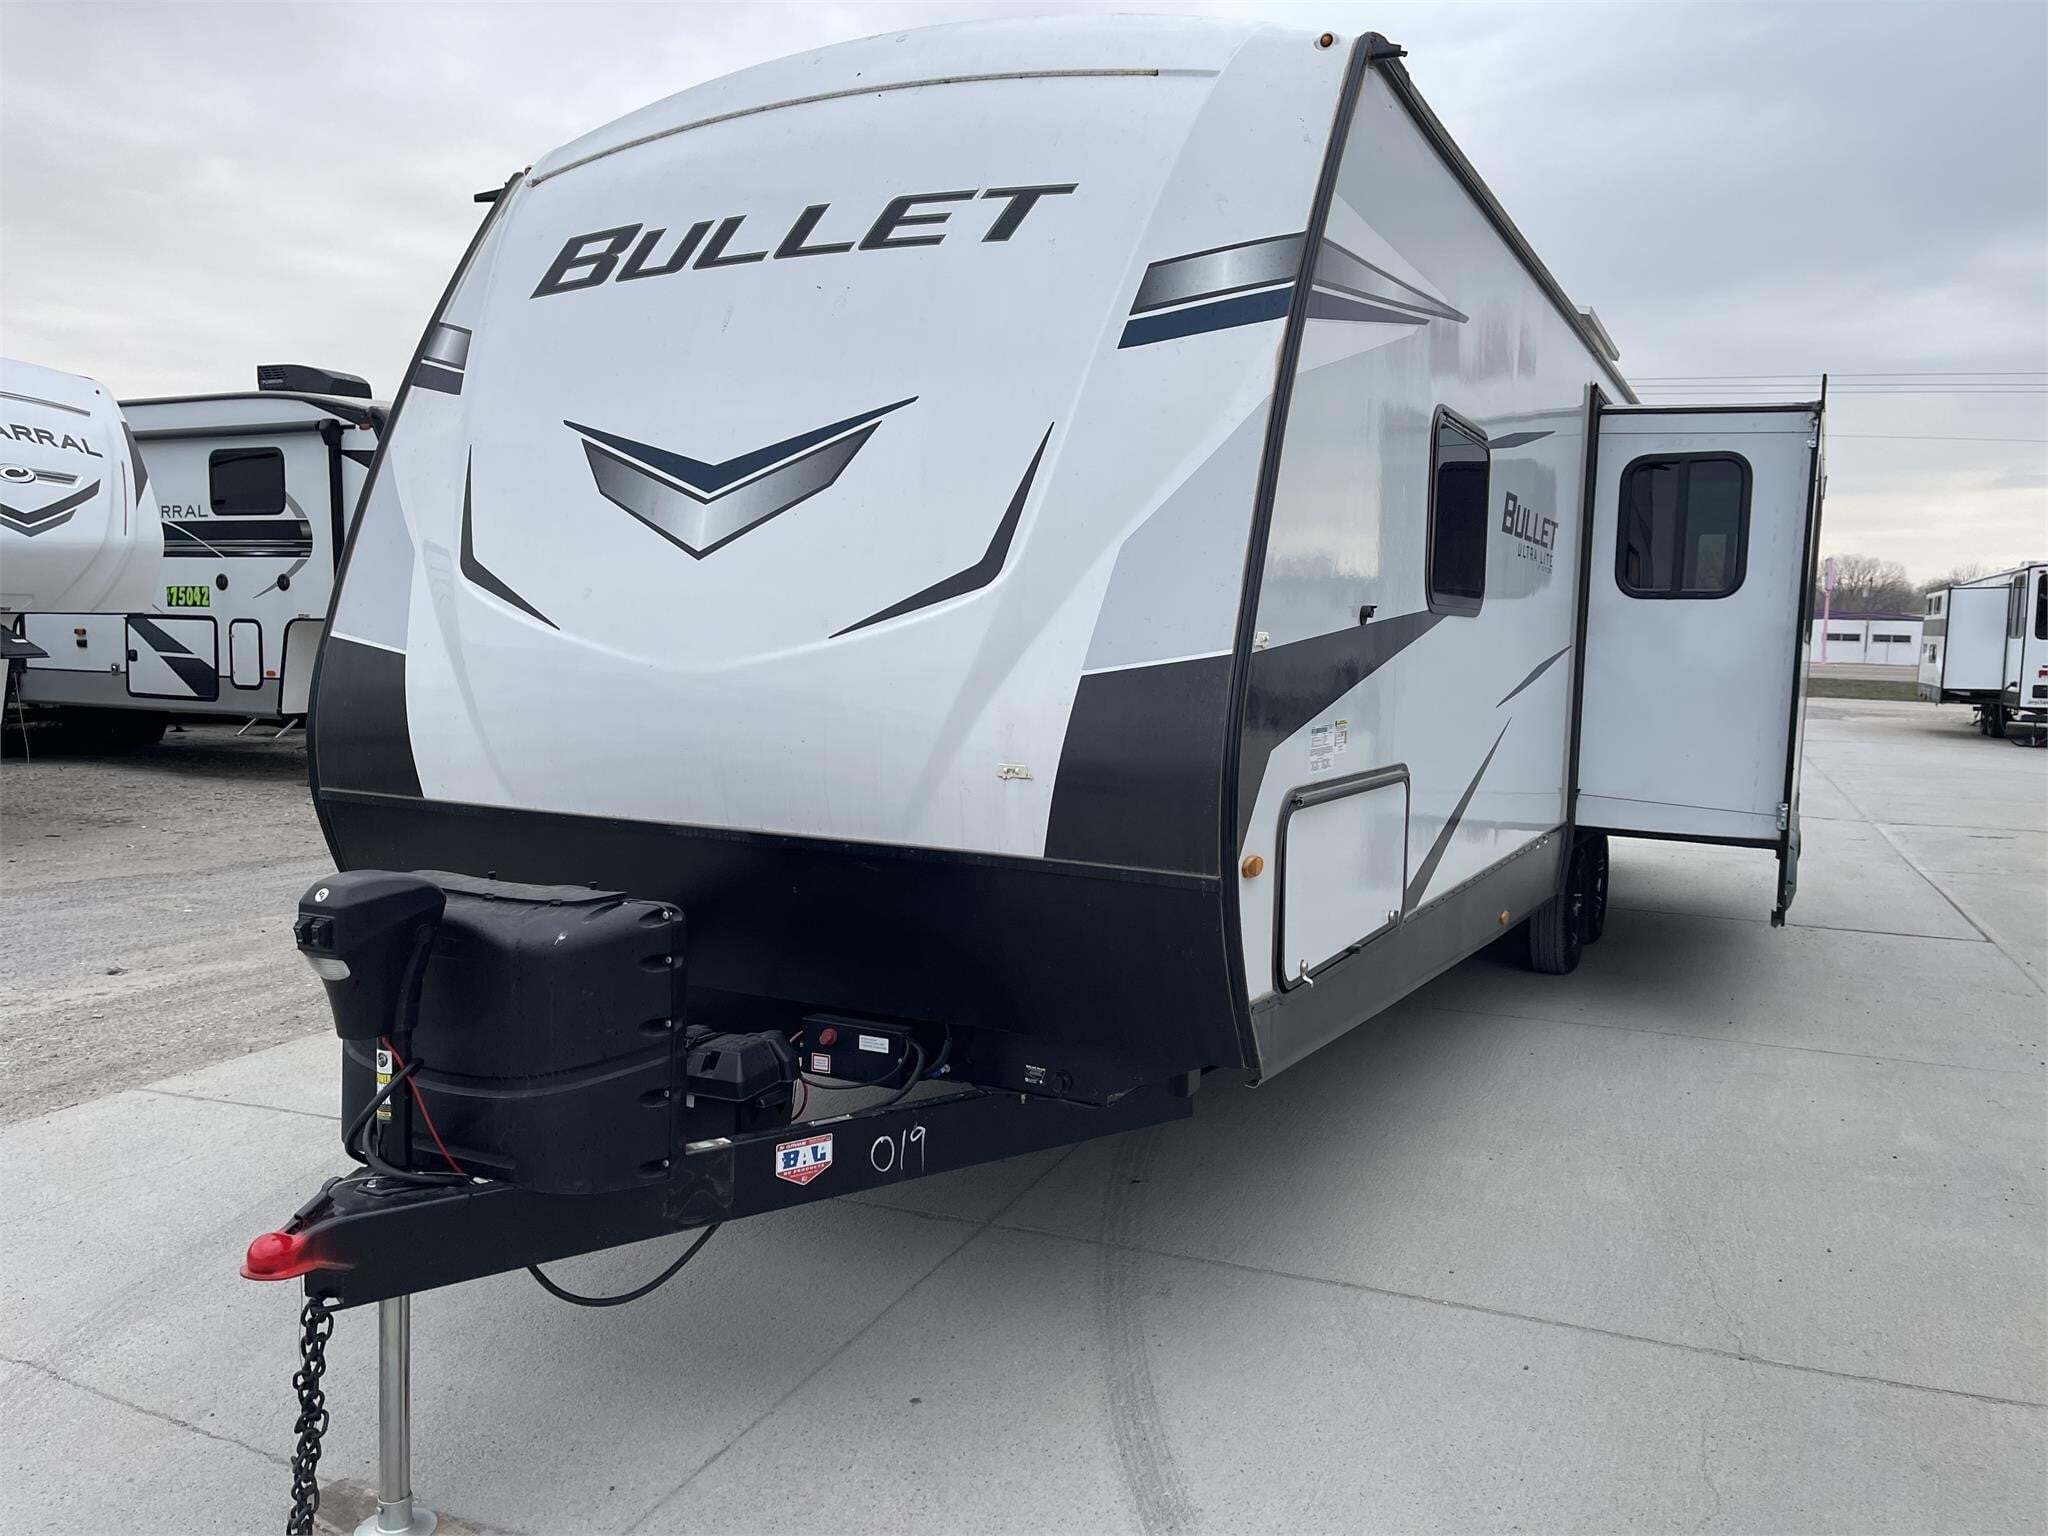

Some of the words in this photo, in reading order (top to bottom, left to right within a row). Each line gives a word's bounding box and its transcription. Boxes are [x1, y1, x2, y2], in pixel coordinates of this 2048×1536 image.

[530, 183, 1079, 299] BULLET
[1502, 491, 1558, 550] BULLET
[871, 1125, 926, 1174] 019
